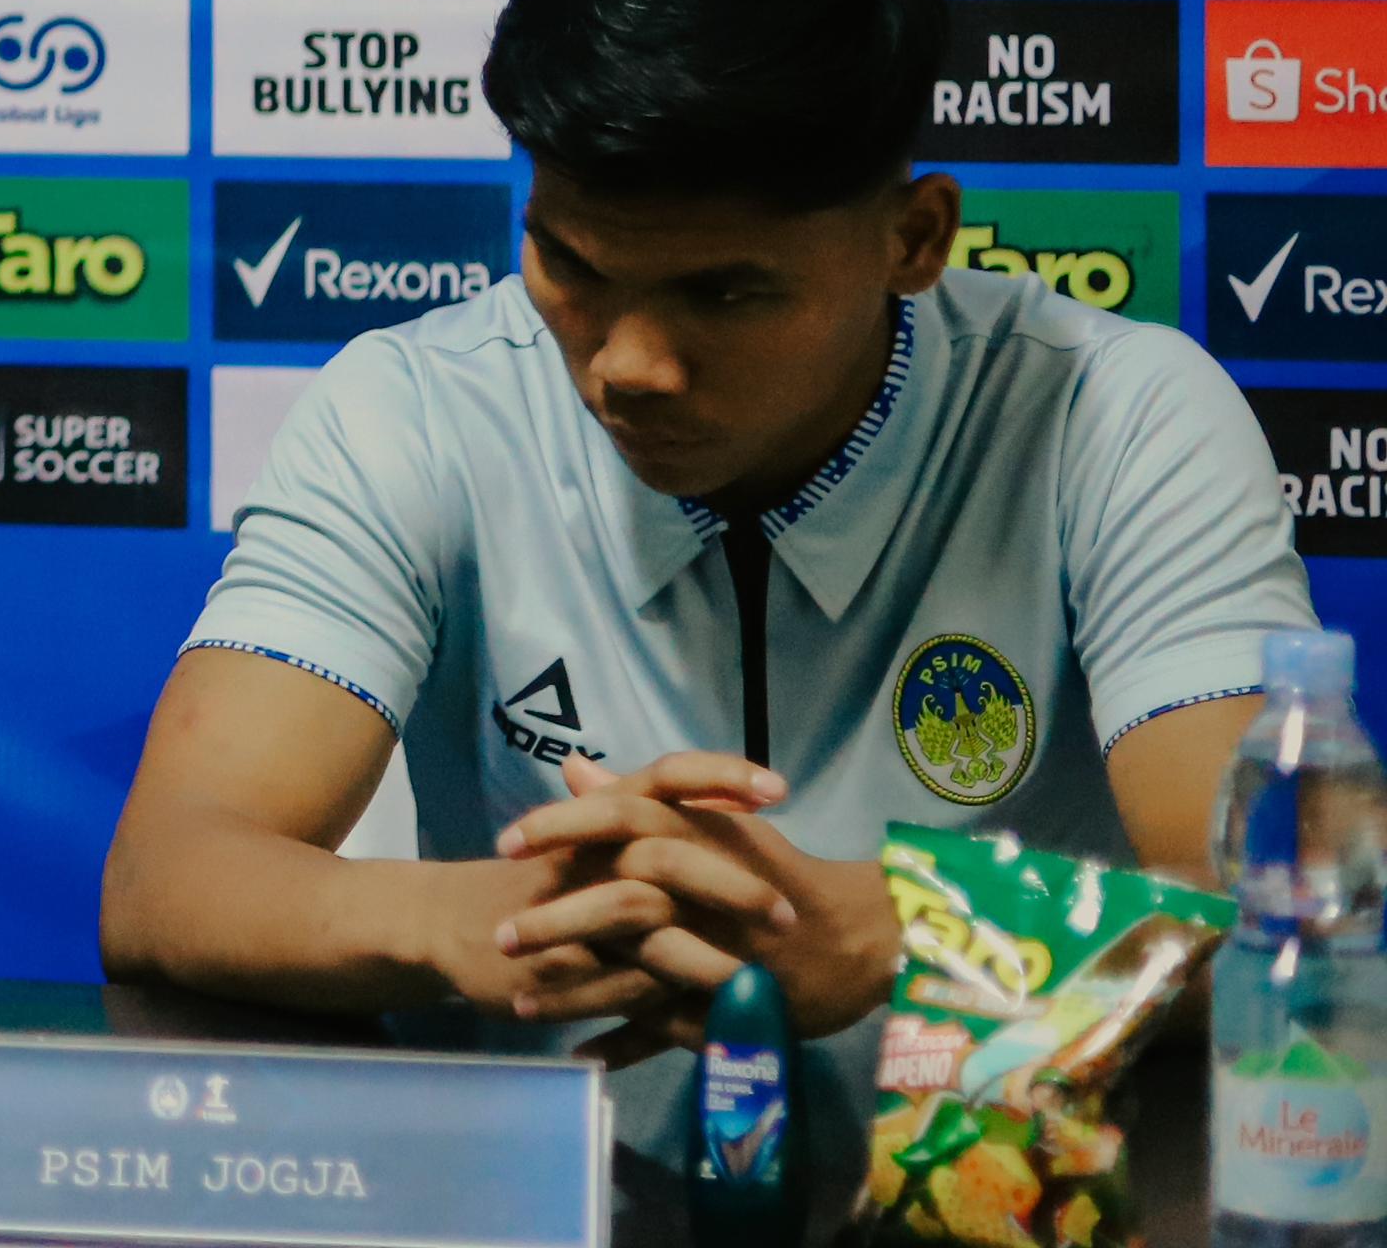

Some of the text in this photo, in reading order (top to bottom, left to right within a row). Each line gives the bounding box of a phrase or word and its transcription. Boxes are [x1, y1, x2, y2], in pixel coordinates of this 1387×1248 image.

[302, 30, 418, 68] STOP
[986, 33, 1055, 78] NO
[254, 77, 471, 116] BULLYING
[933, 81, 1111, 126] RACISM
[304, 250, 489, 300] Rexona
[14, 415, 131, 449] SUPER
[14, 450, 160, 484] SOCCER
[918, 652, 984, 686] PSIM
[1278, 1100, 1320, 1136] Le
[1238, 1124, 1370, 1159] Minerale
[40, 1149, 368, 1199] PSIM JOGJA
